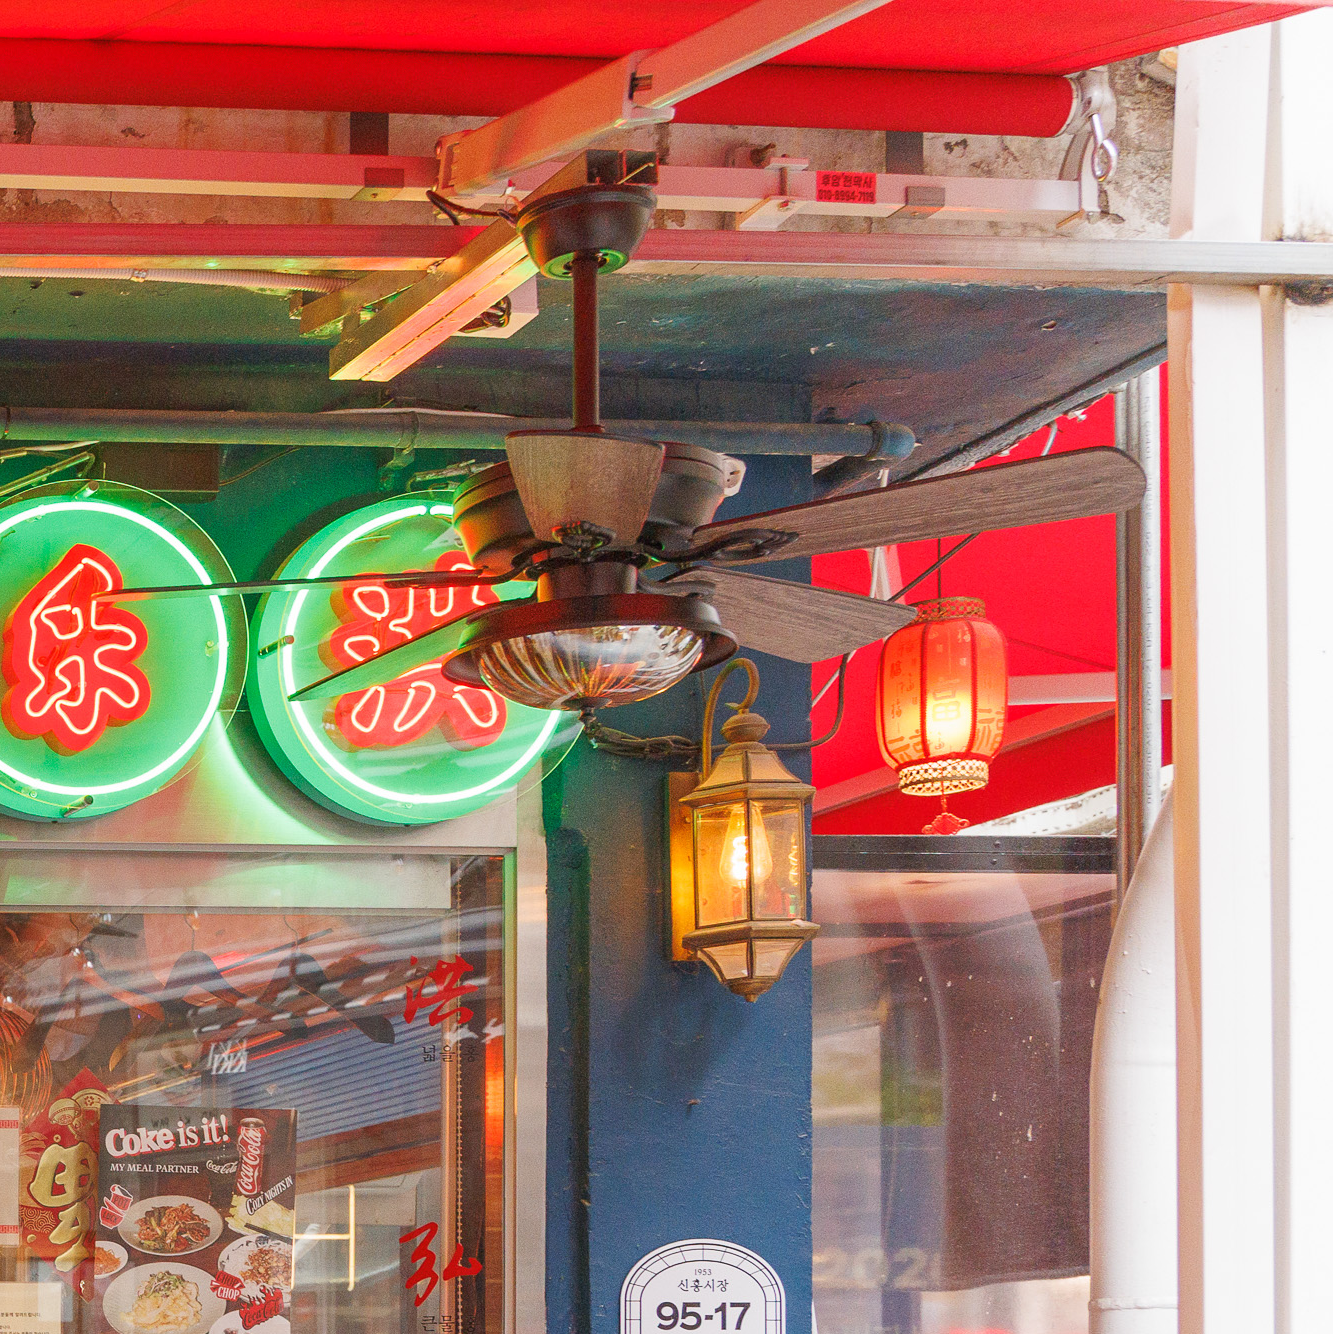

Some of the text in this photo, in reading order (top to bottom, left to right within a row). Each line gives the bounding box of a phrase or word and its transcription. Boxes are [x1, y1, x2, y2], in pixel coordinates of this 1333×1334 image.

[105, 1114, 231, 1159] Coke is it!
[110, 1163, 200, 1174] MY MEAL PARTNER
[237, 1127, 264, 1196] Coca-Cola
[264, 1179, 288, 1201] NIGHTS
[218, 1286, 240, 1300] CHOP
[677, 1278, 729, 1292] 신흥시장
[656, 1302, 751, 1331] 95-17
